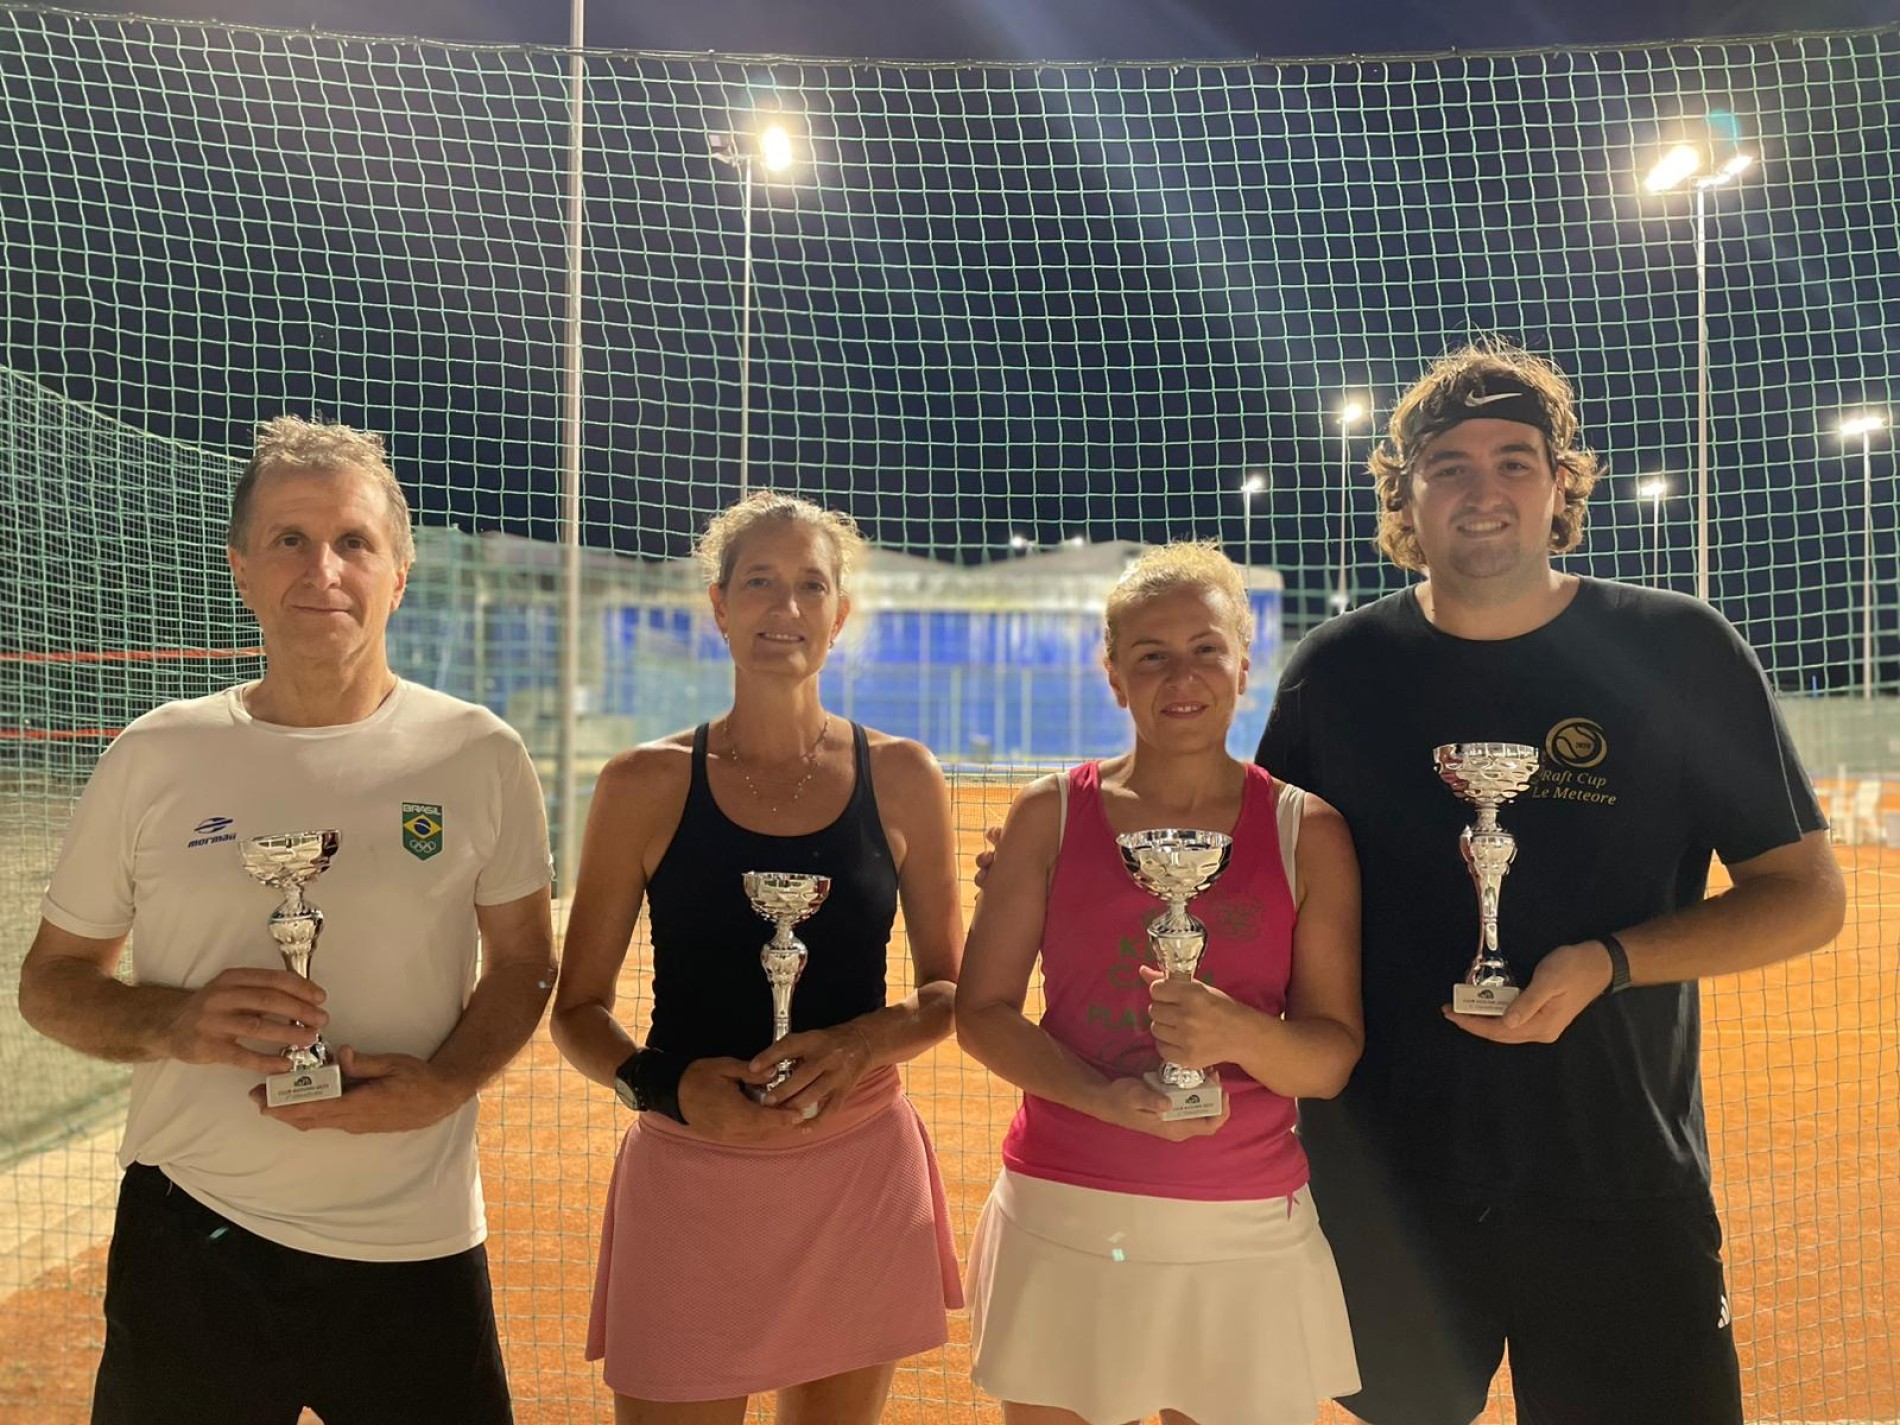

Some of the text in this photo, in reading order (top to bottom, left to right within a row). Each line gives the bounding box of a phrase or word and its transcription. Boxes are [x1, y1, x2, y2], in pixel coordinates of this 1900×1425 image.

[1541, 770, 1607, 789] Raft Cup
[1532, 786, 1617, 805] Le Meteore
[403, 803, 441, 816] BRASIL
